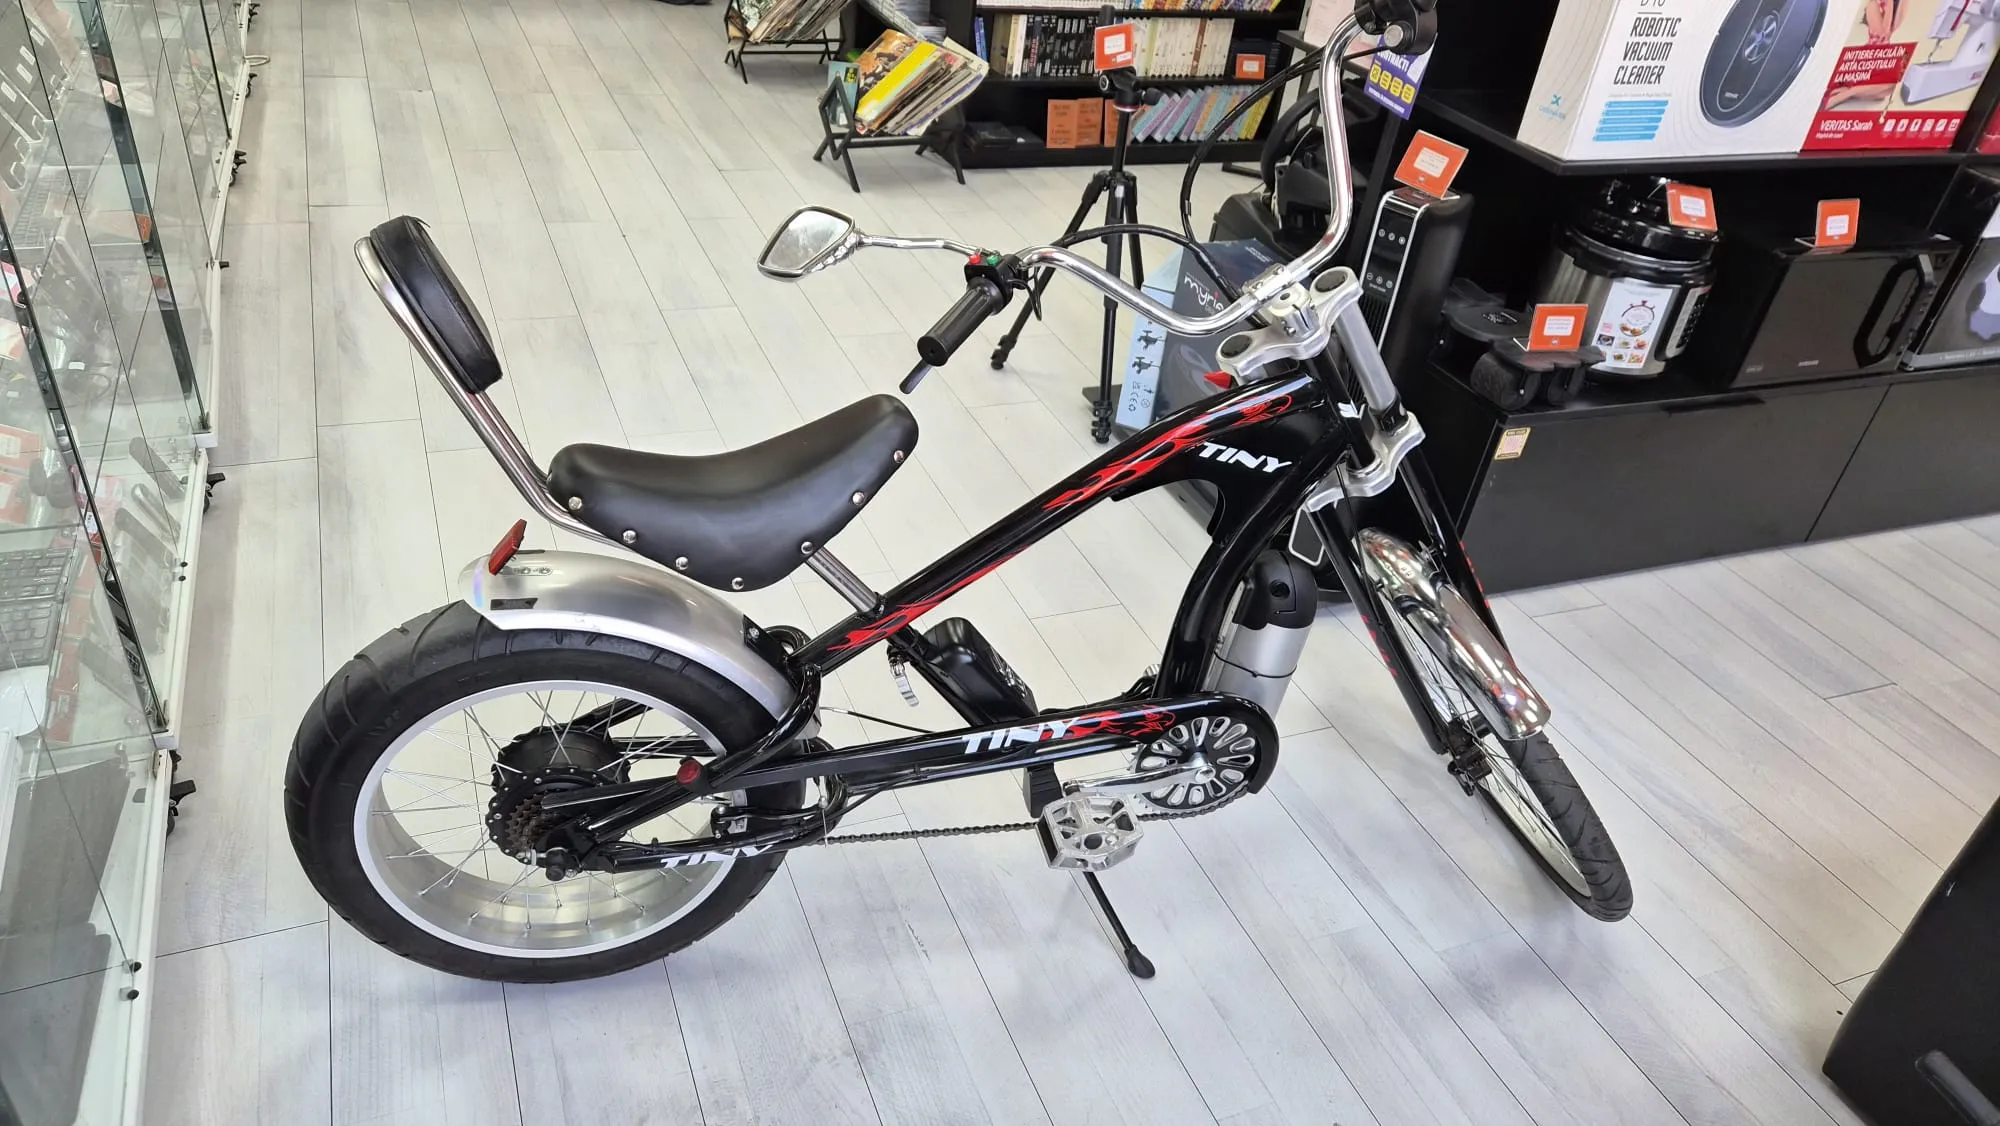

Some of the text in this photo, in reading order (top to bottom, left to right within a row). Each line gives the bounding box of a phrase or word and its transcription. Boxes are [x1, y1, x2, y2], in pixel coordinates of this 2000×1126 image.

[1630, 17, 1682, 37] ROBOTIC
[1622, 41, 1674, 62] VACUUM
[1613, 65, 1665, 85] CLEANER
[1839, 59, 1897, 71] ARTA CUSUTULUI
[1834, 73, 1844, 83] LA
[1820, 120, 1873, 131] VERITAS Sarah
[1199, 441, 1293, 473] TINY
[962, 716, 1080, 754] TINY
[660, 844, 774, 869] TINY
